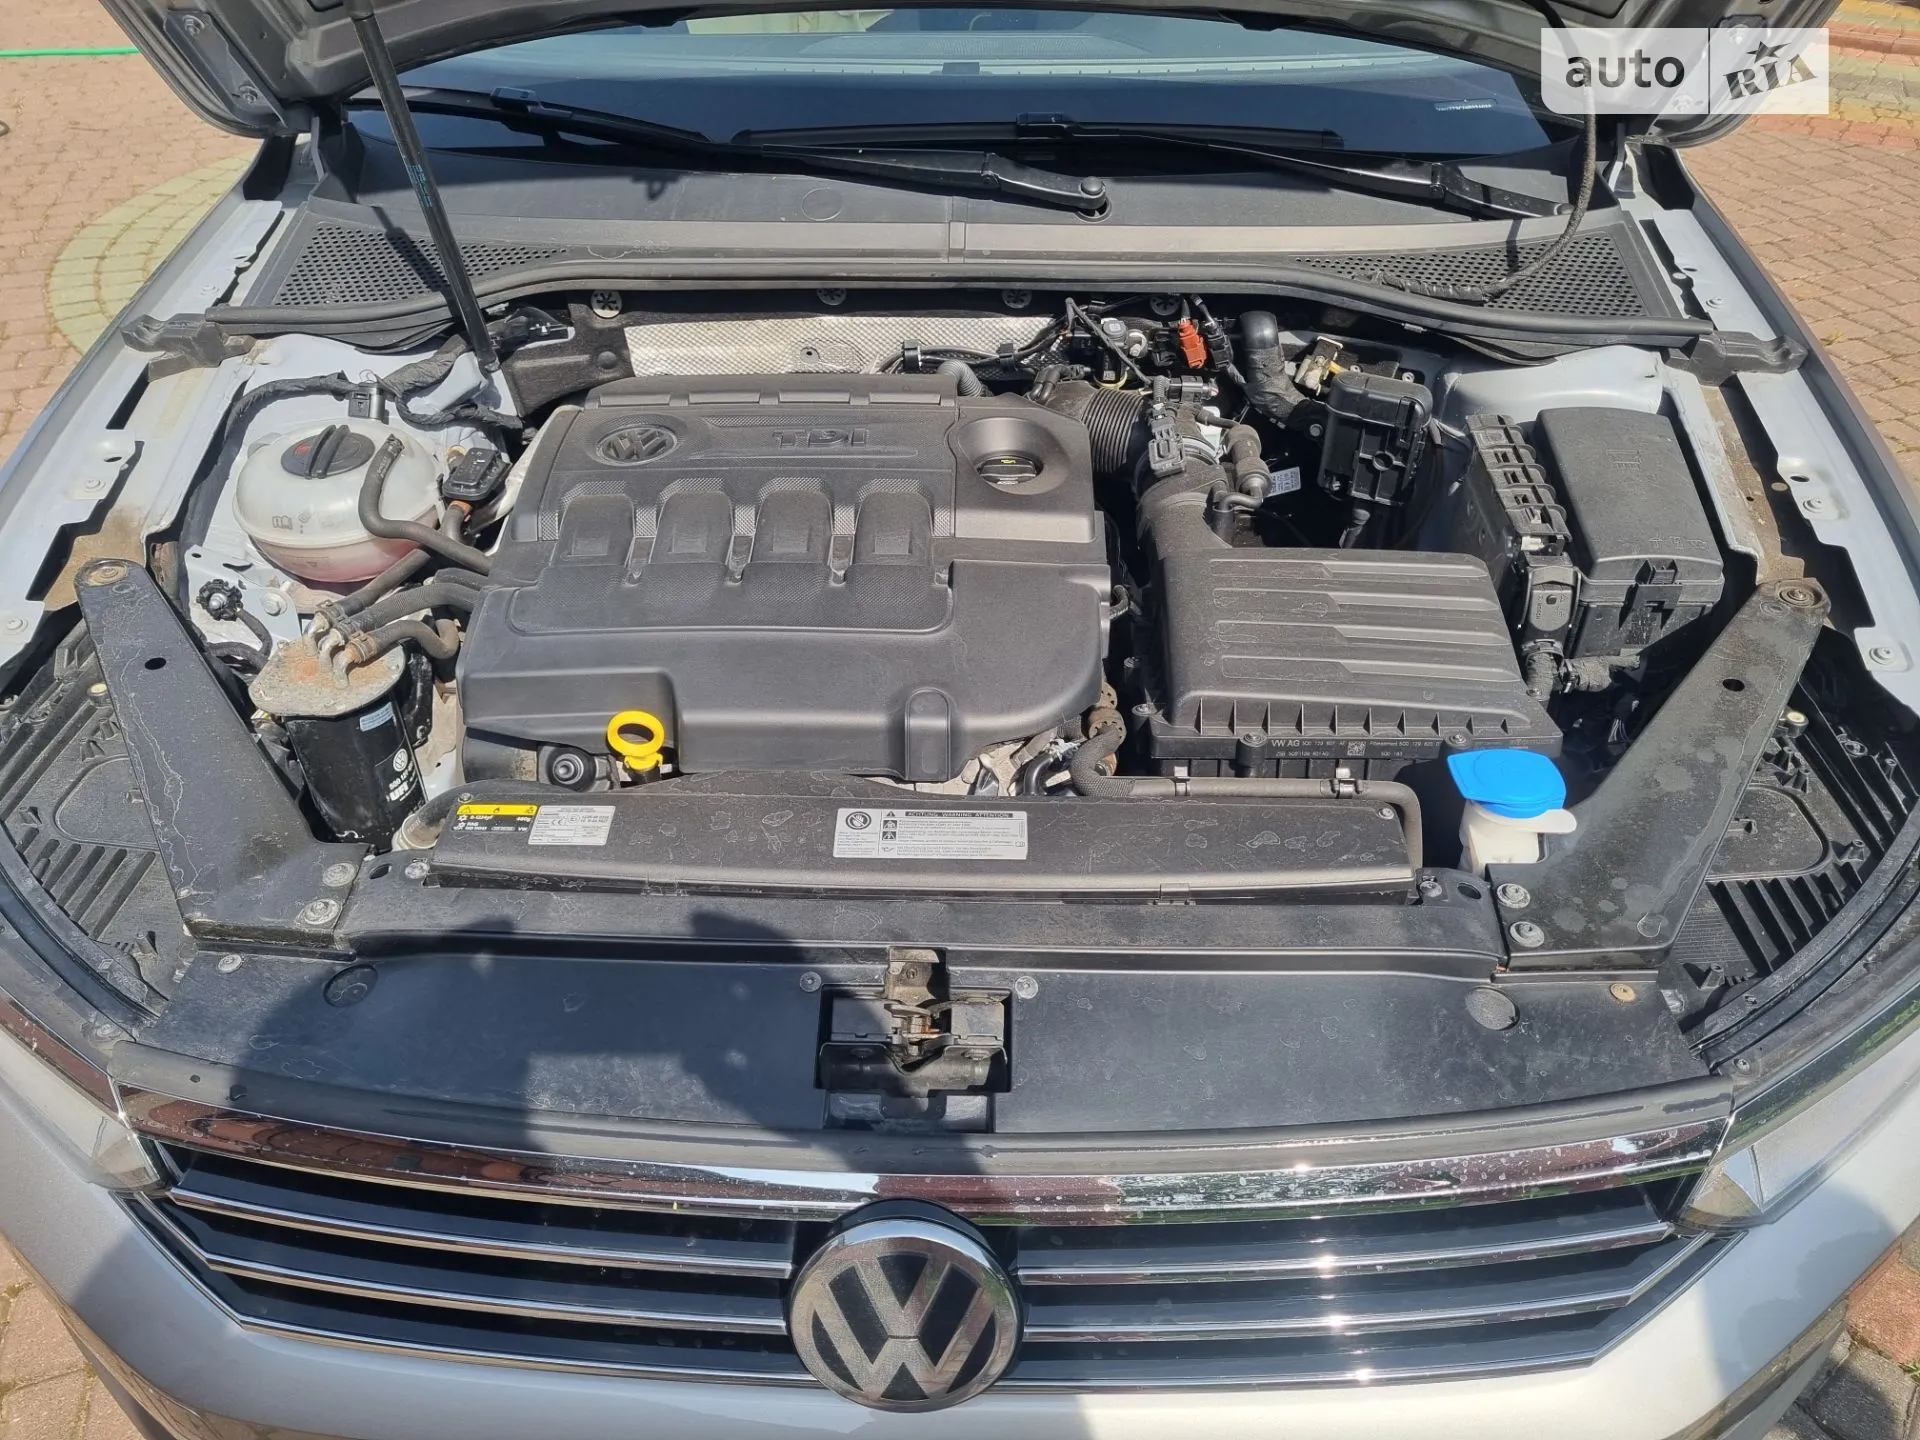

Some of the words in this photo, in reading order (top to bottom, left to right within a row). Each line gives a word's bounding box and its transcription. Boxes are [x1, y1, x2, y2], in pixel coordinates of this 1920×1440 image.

[772, 427, 865, 447] TDI
[1271, 739, 1286, 748] VW
[1287, 739, 1301, 748] AG
[796, 1228, 1012, 1408] VW
